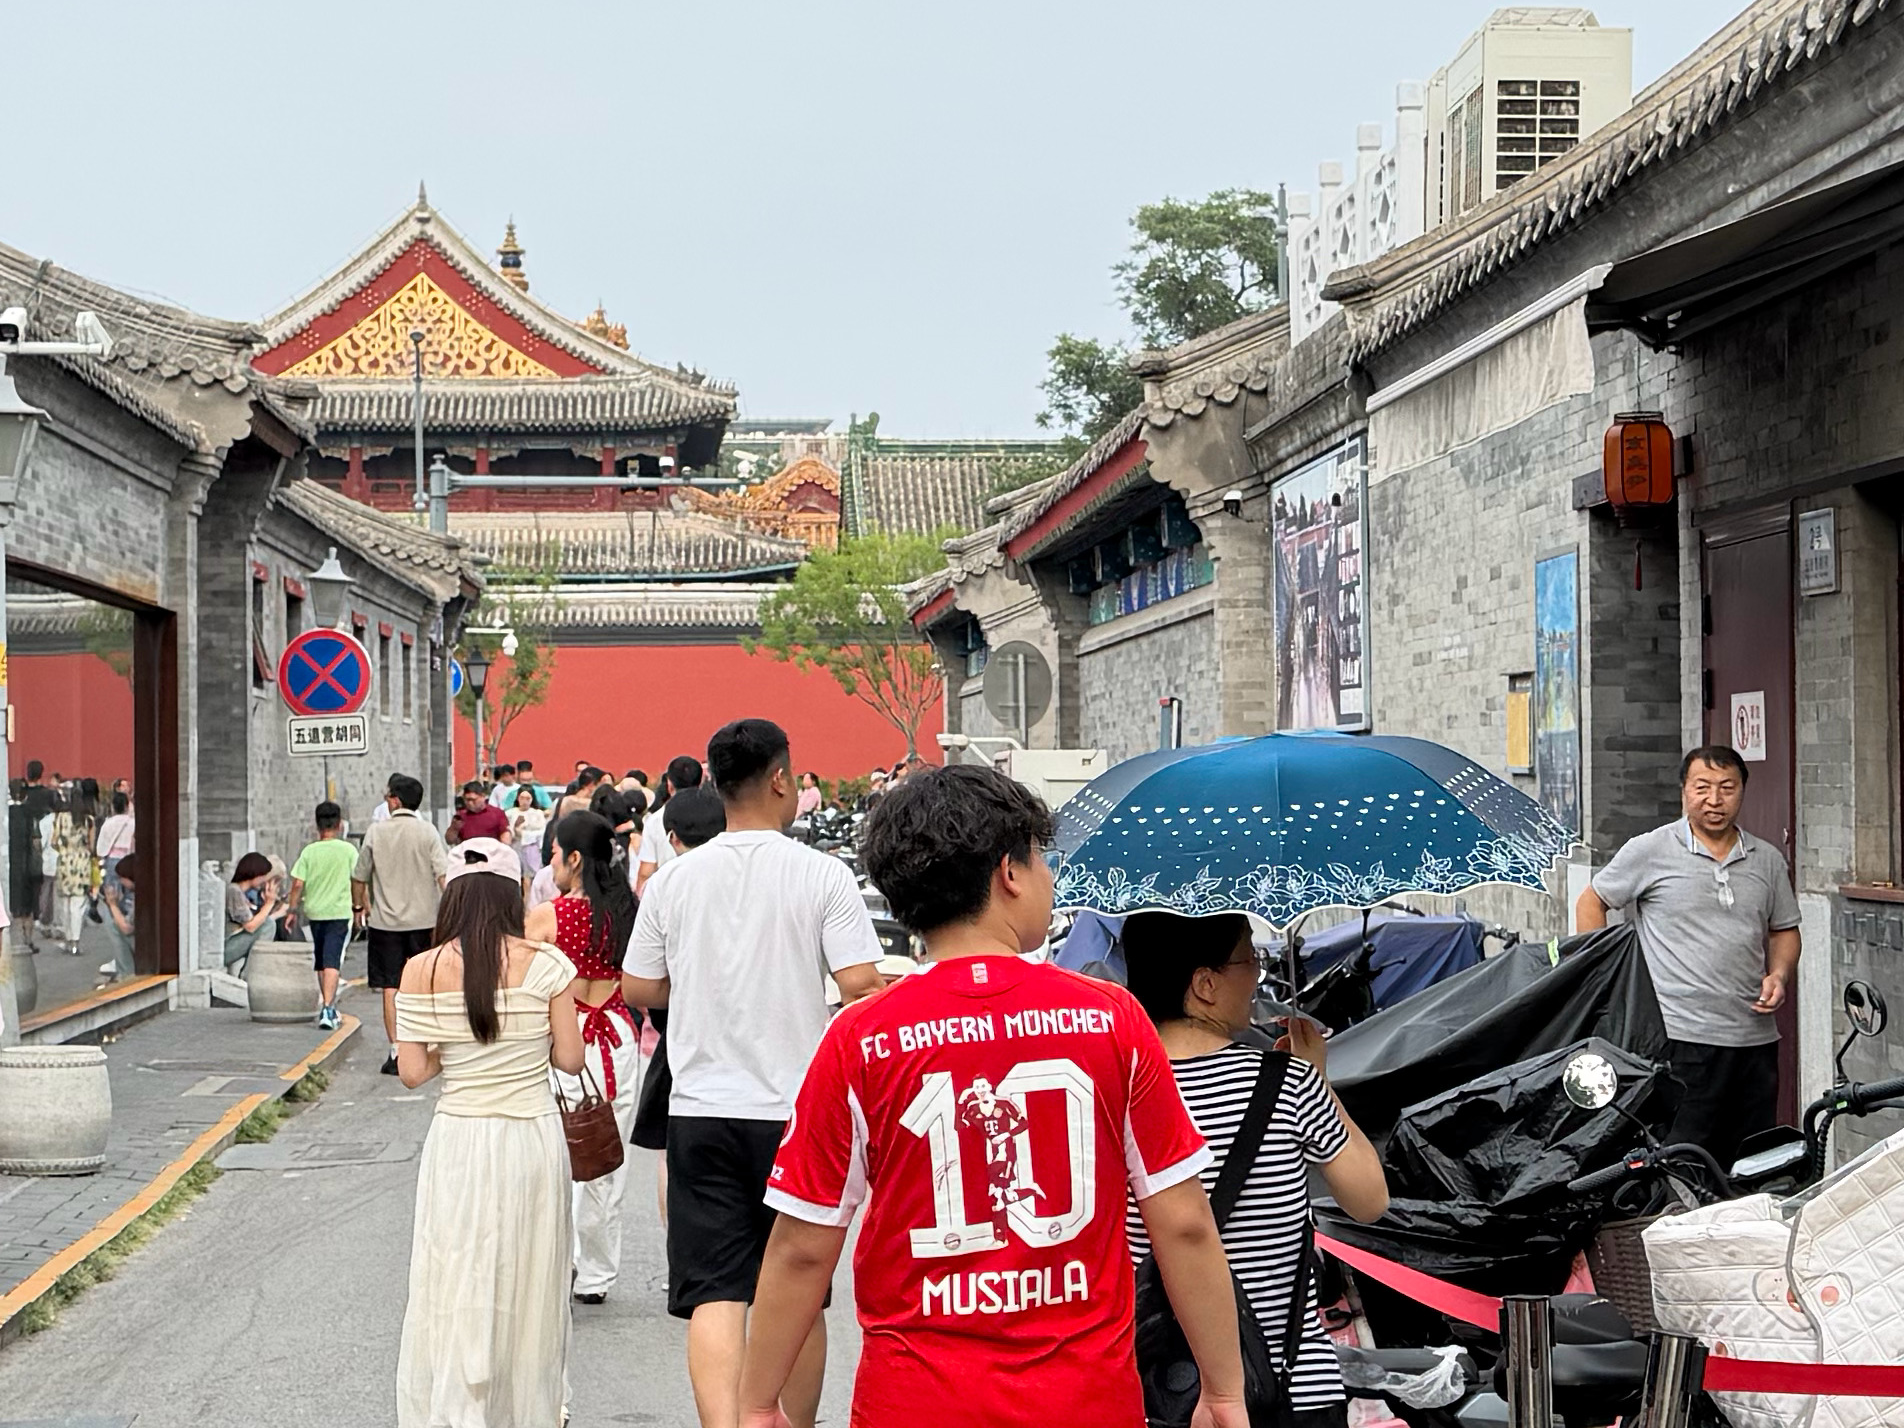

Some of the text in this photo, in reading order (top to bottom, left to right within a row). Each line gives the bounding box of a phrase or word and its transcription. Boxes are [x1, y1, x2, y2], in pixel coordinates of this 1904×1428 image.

[860, 1007, 1115, 1065] FC BAYERN MÜNCHEN
[898, 1057, 1097, 1259] 10
[921, 1260, 1089, 1316] MUSIALA
